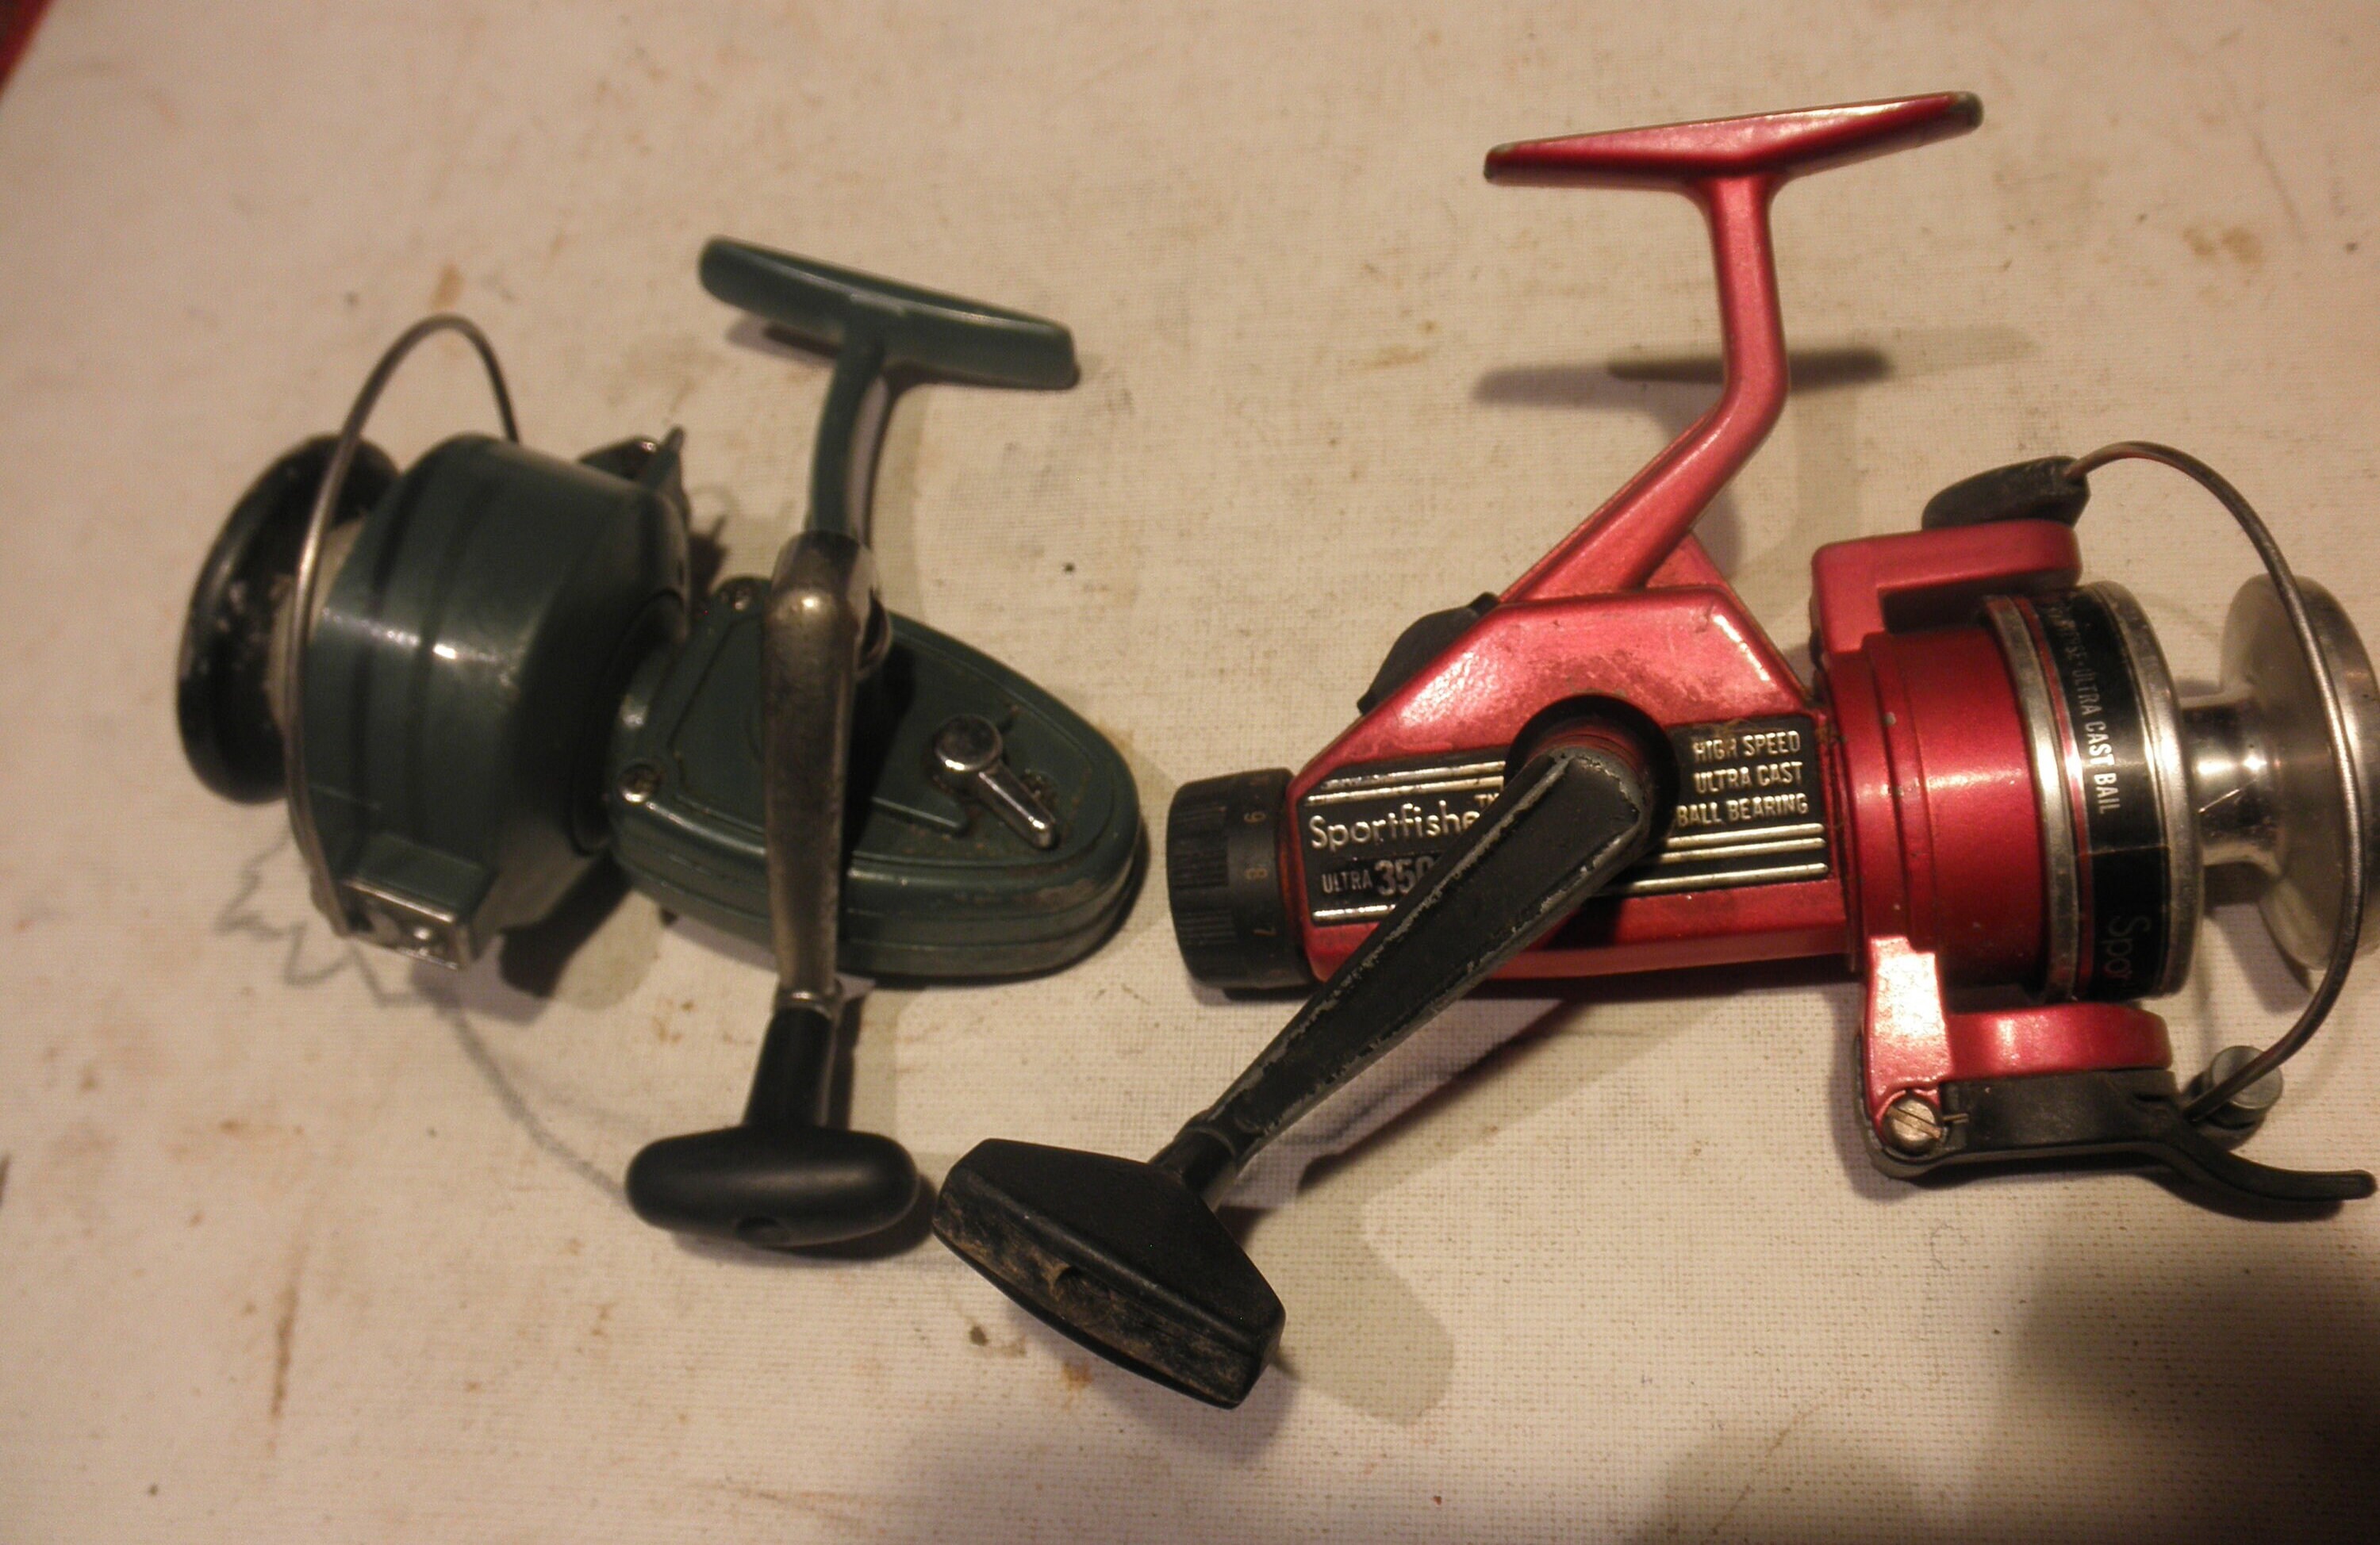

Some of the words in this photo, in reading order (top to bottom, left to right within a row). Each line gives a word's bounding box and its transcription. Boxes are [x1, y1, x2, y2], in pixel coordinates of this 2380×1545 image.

[1743, 730, 1801, 757] SPEED
[2086, 721, 2115, 766] CAST
[1694, 766, 1752, 794] ULTRA
[1756, 761, 1803, 786] CAST
[2094, 772, 2121, 814] BAIL
[1308, 799, 1481, 852] Sportfishe
[1676, 802, 1722, 827] BALL
[1726, 792, 1809, 822] BEARING
[1321, 869, 1372, 894] ULTRA
